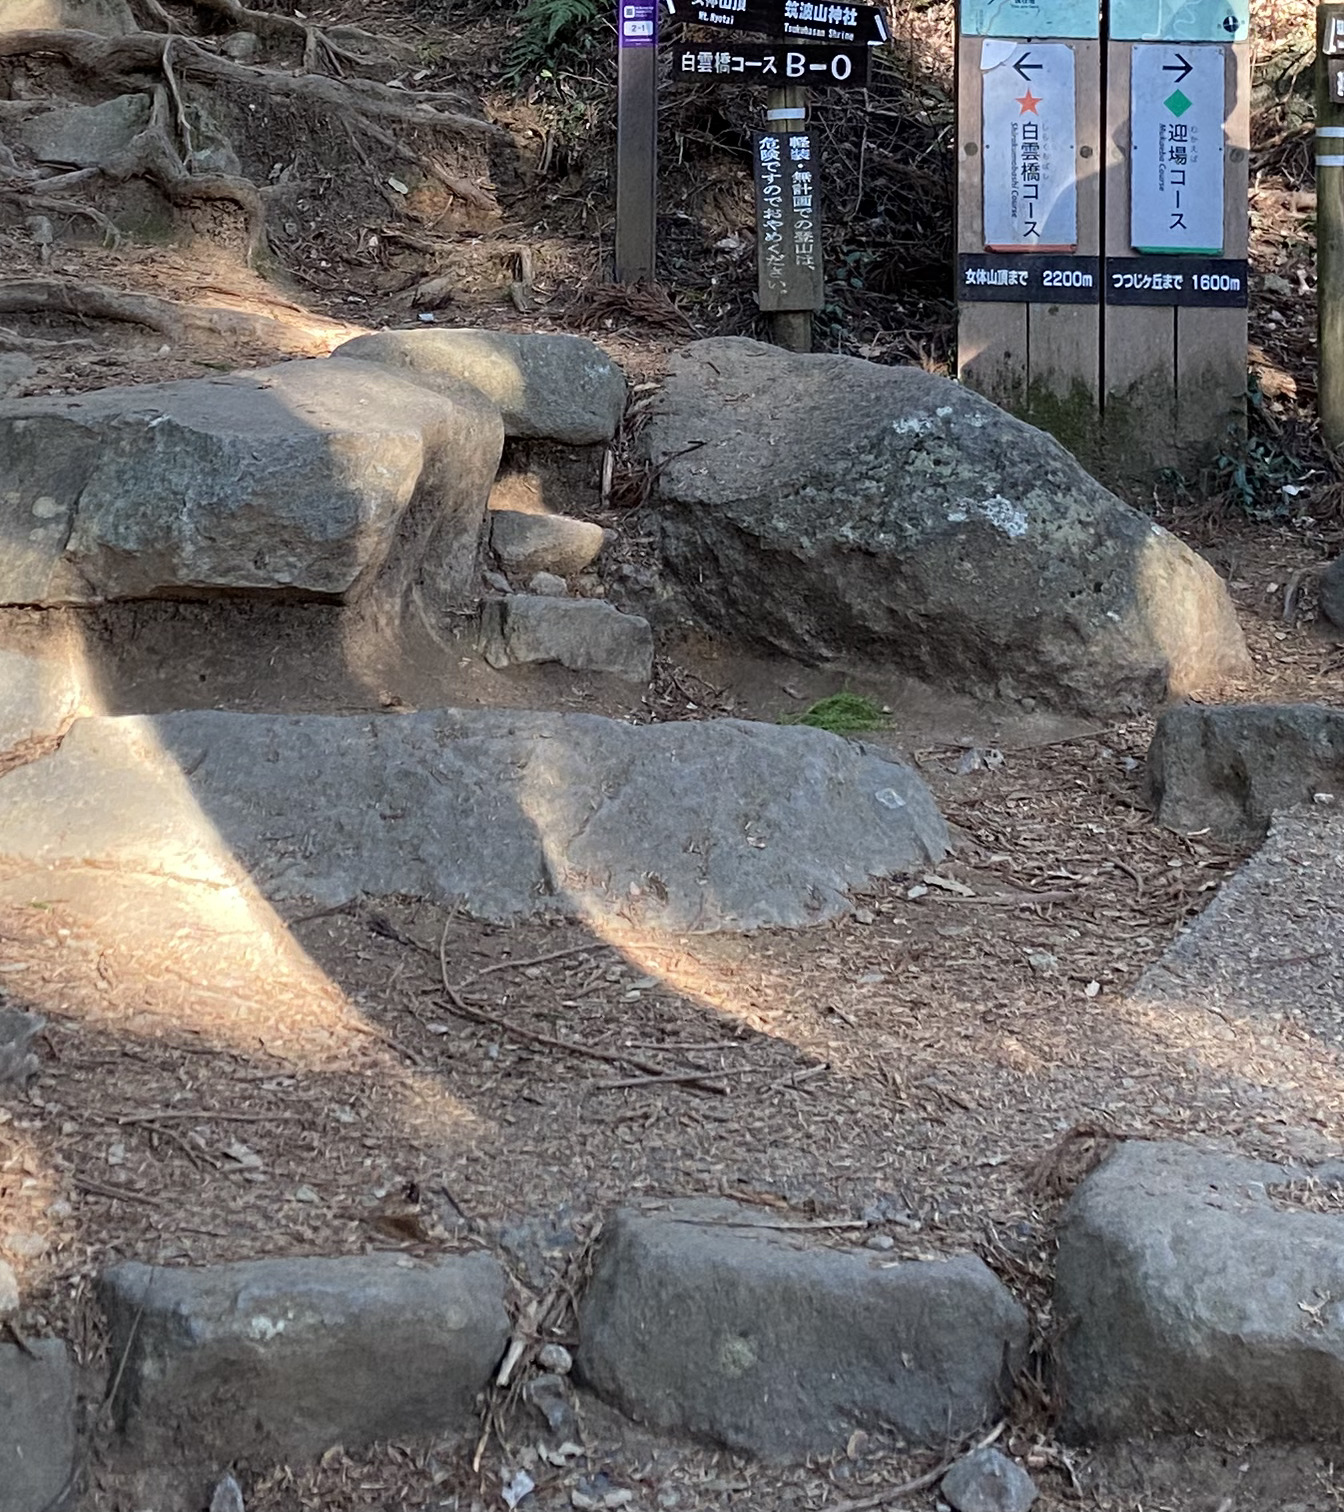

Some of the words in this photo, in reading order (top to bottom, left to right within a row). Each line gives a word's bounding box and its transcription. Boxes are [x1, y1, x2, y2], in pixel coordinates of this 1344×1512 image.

[784, 0, 858, 27] 筑波山神社
[681, 51, 778, 75] 白雲橋コース
[1020, 121, 1041, 238] 白雲橋コース
[1168, 123, 1188, 230] 迎場コース
[965, 268, 1029, 286] 女体山頂まで
[1042, 270, 1093, 287] 2200m
[1192, 274, 1241, 291] 1600m
